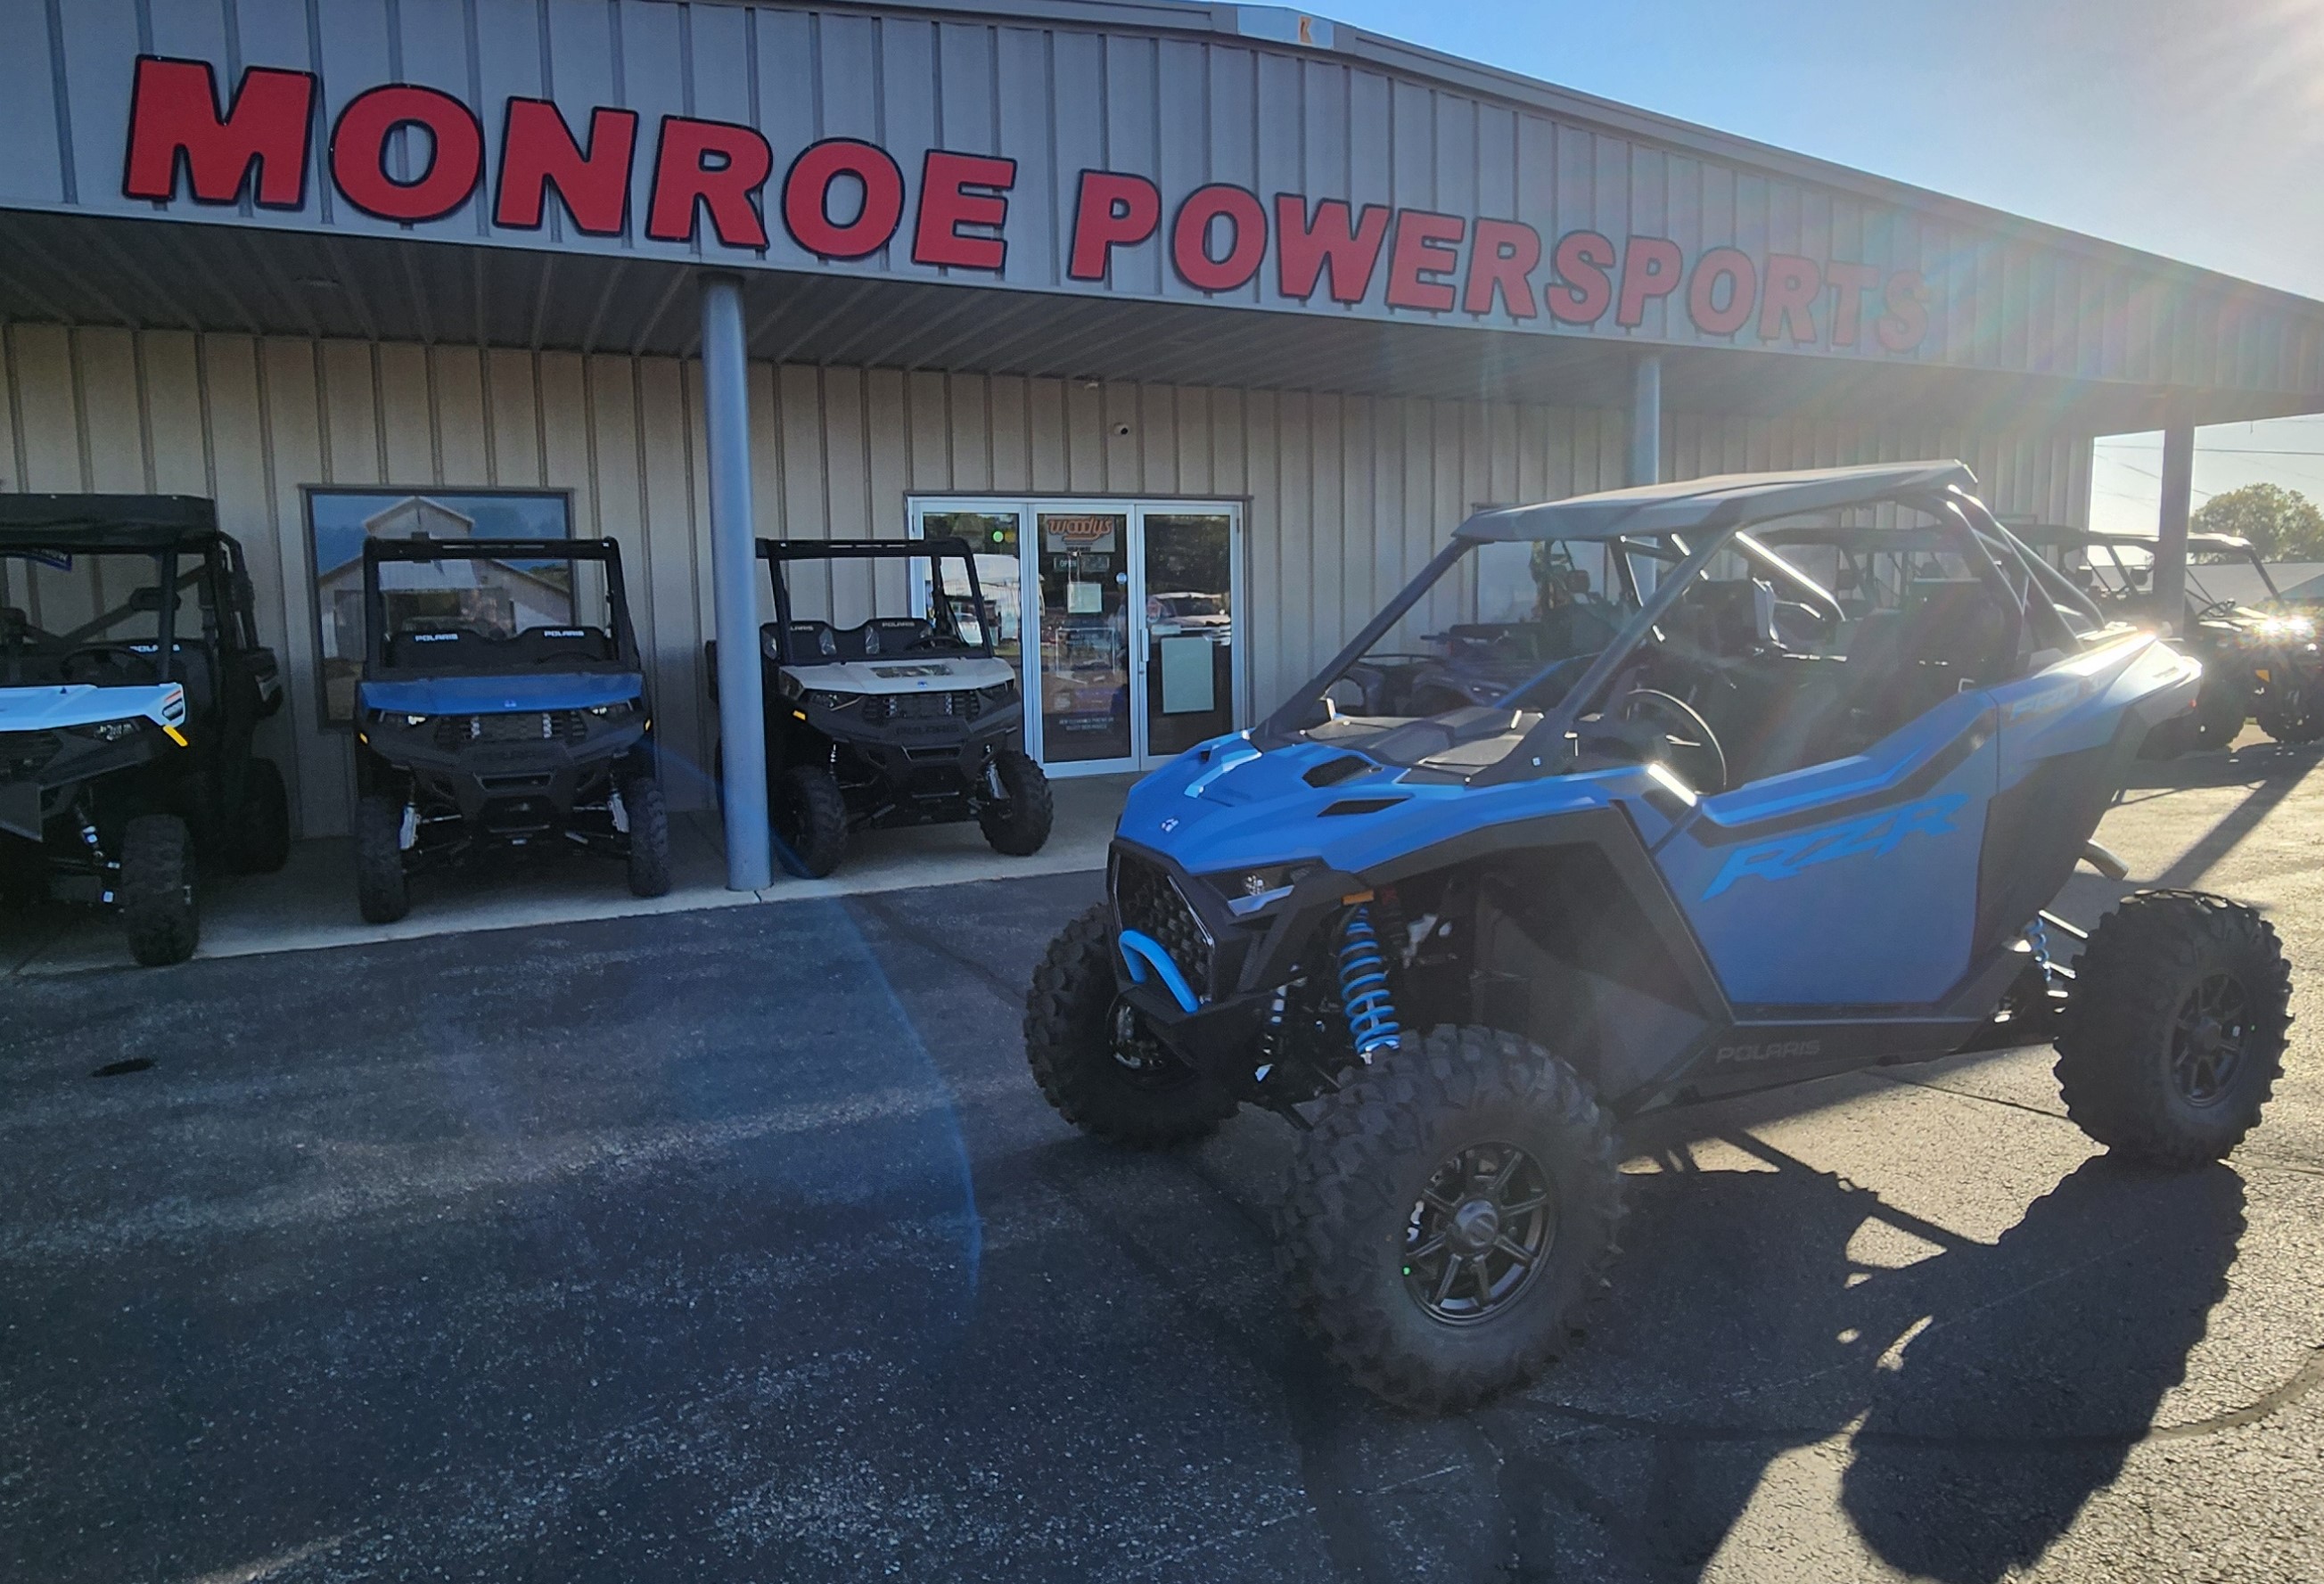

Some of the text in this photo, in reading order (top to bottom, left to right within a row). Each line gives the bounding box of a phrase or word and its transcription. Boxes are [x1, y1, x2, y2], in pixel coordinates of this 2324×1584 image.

[123, 53, 1932, 355] MONROE POWERSPORTS
[415, 633, 459, 642] POLARIS
[544, 629, 585, 637] POLARIS
[1701, 792, 1970, 902] RZR
[1715, 1039, 1821, 1063] POLARIS
